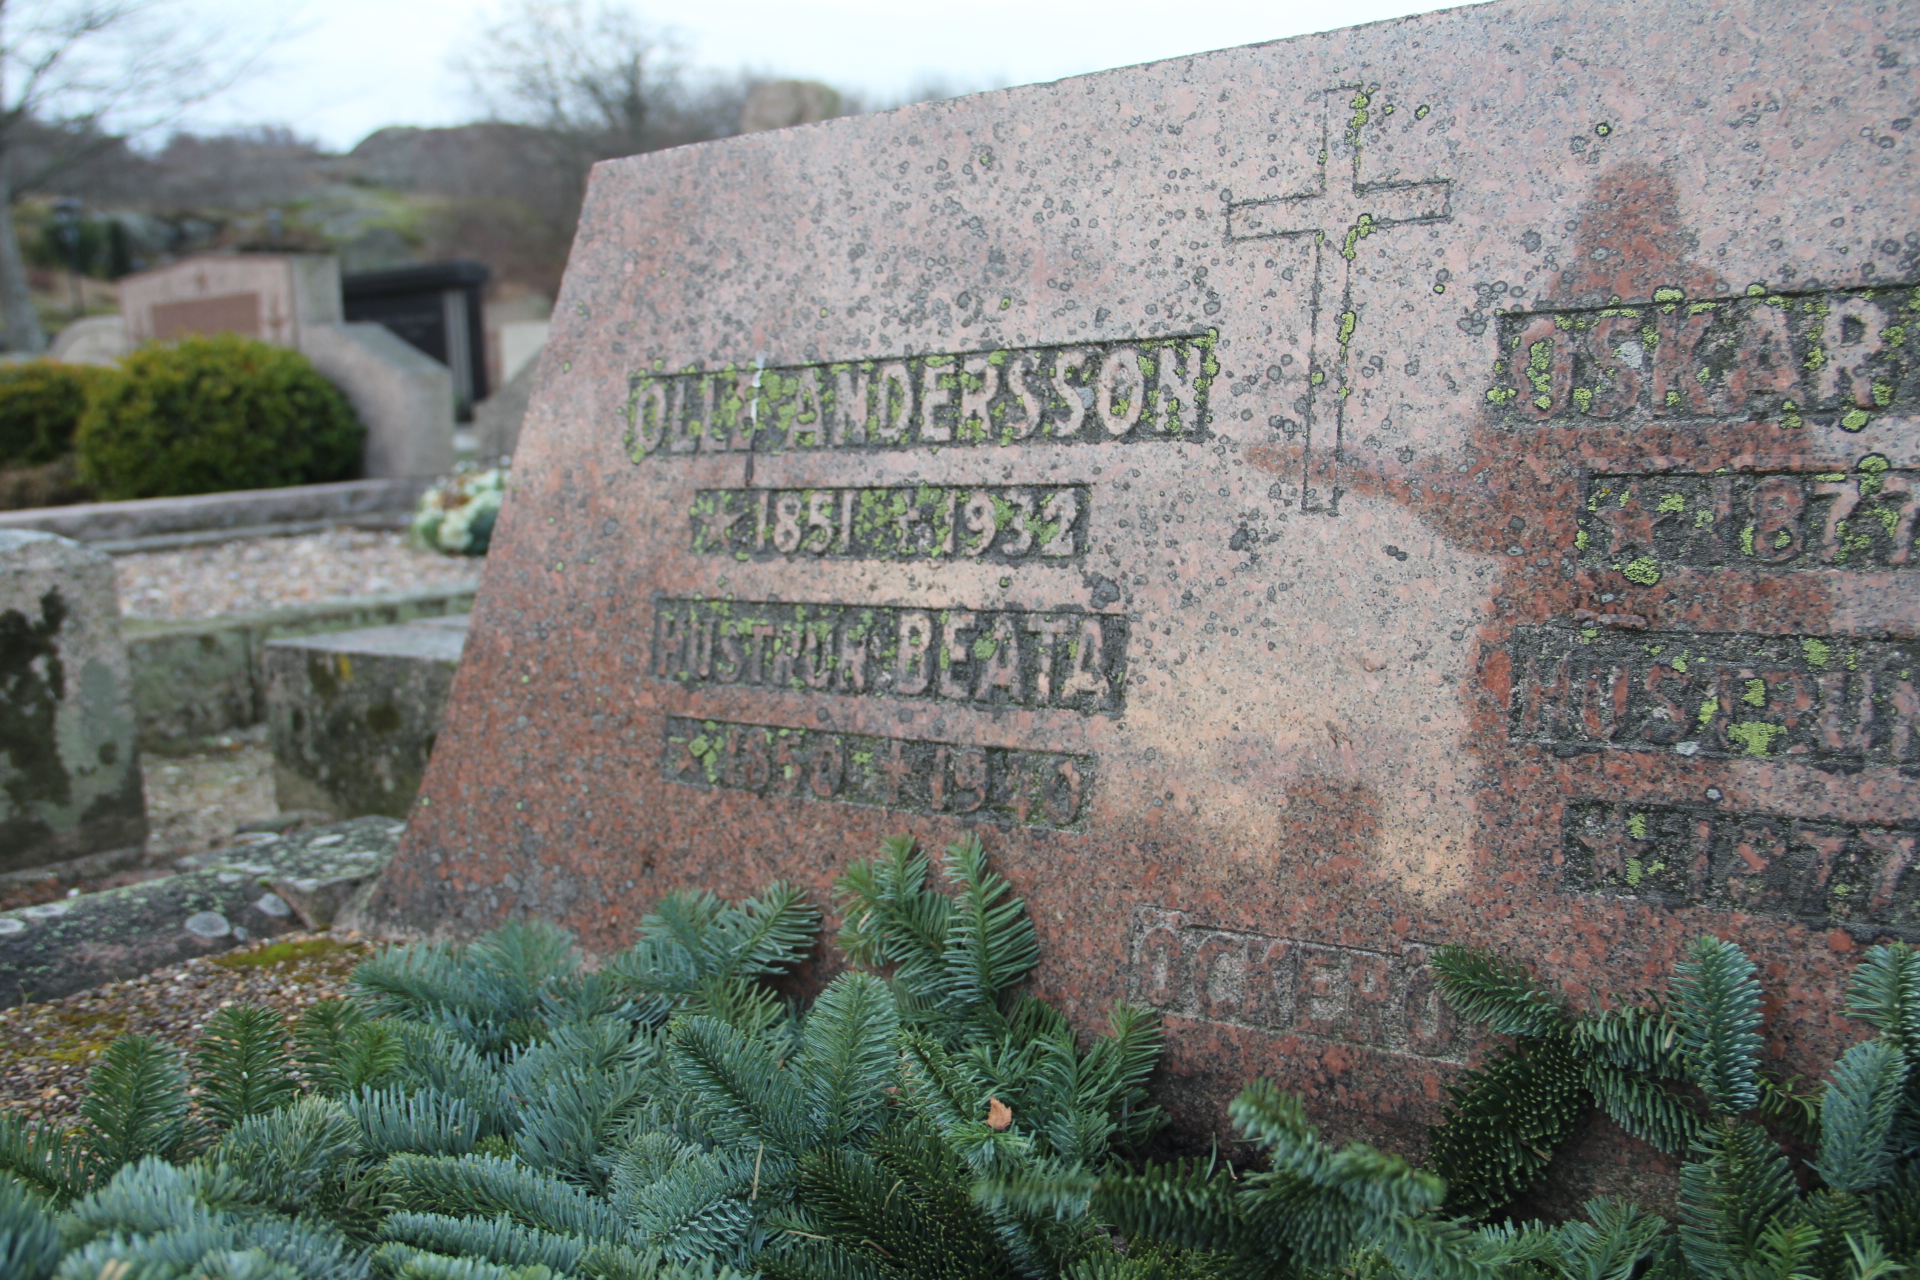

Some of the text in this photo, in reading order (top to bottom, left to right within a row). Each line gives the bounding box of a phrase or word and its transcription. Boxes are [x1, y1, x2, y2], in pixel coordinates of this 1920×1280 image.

[787, 344, 1203, 446] ANDERSSON
[1511, 296, 1889, 421] OSKAR
[756, 489, 1078, 557] 1851 1932
[897, 609, 1112, 706] BEATA
